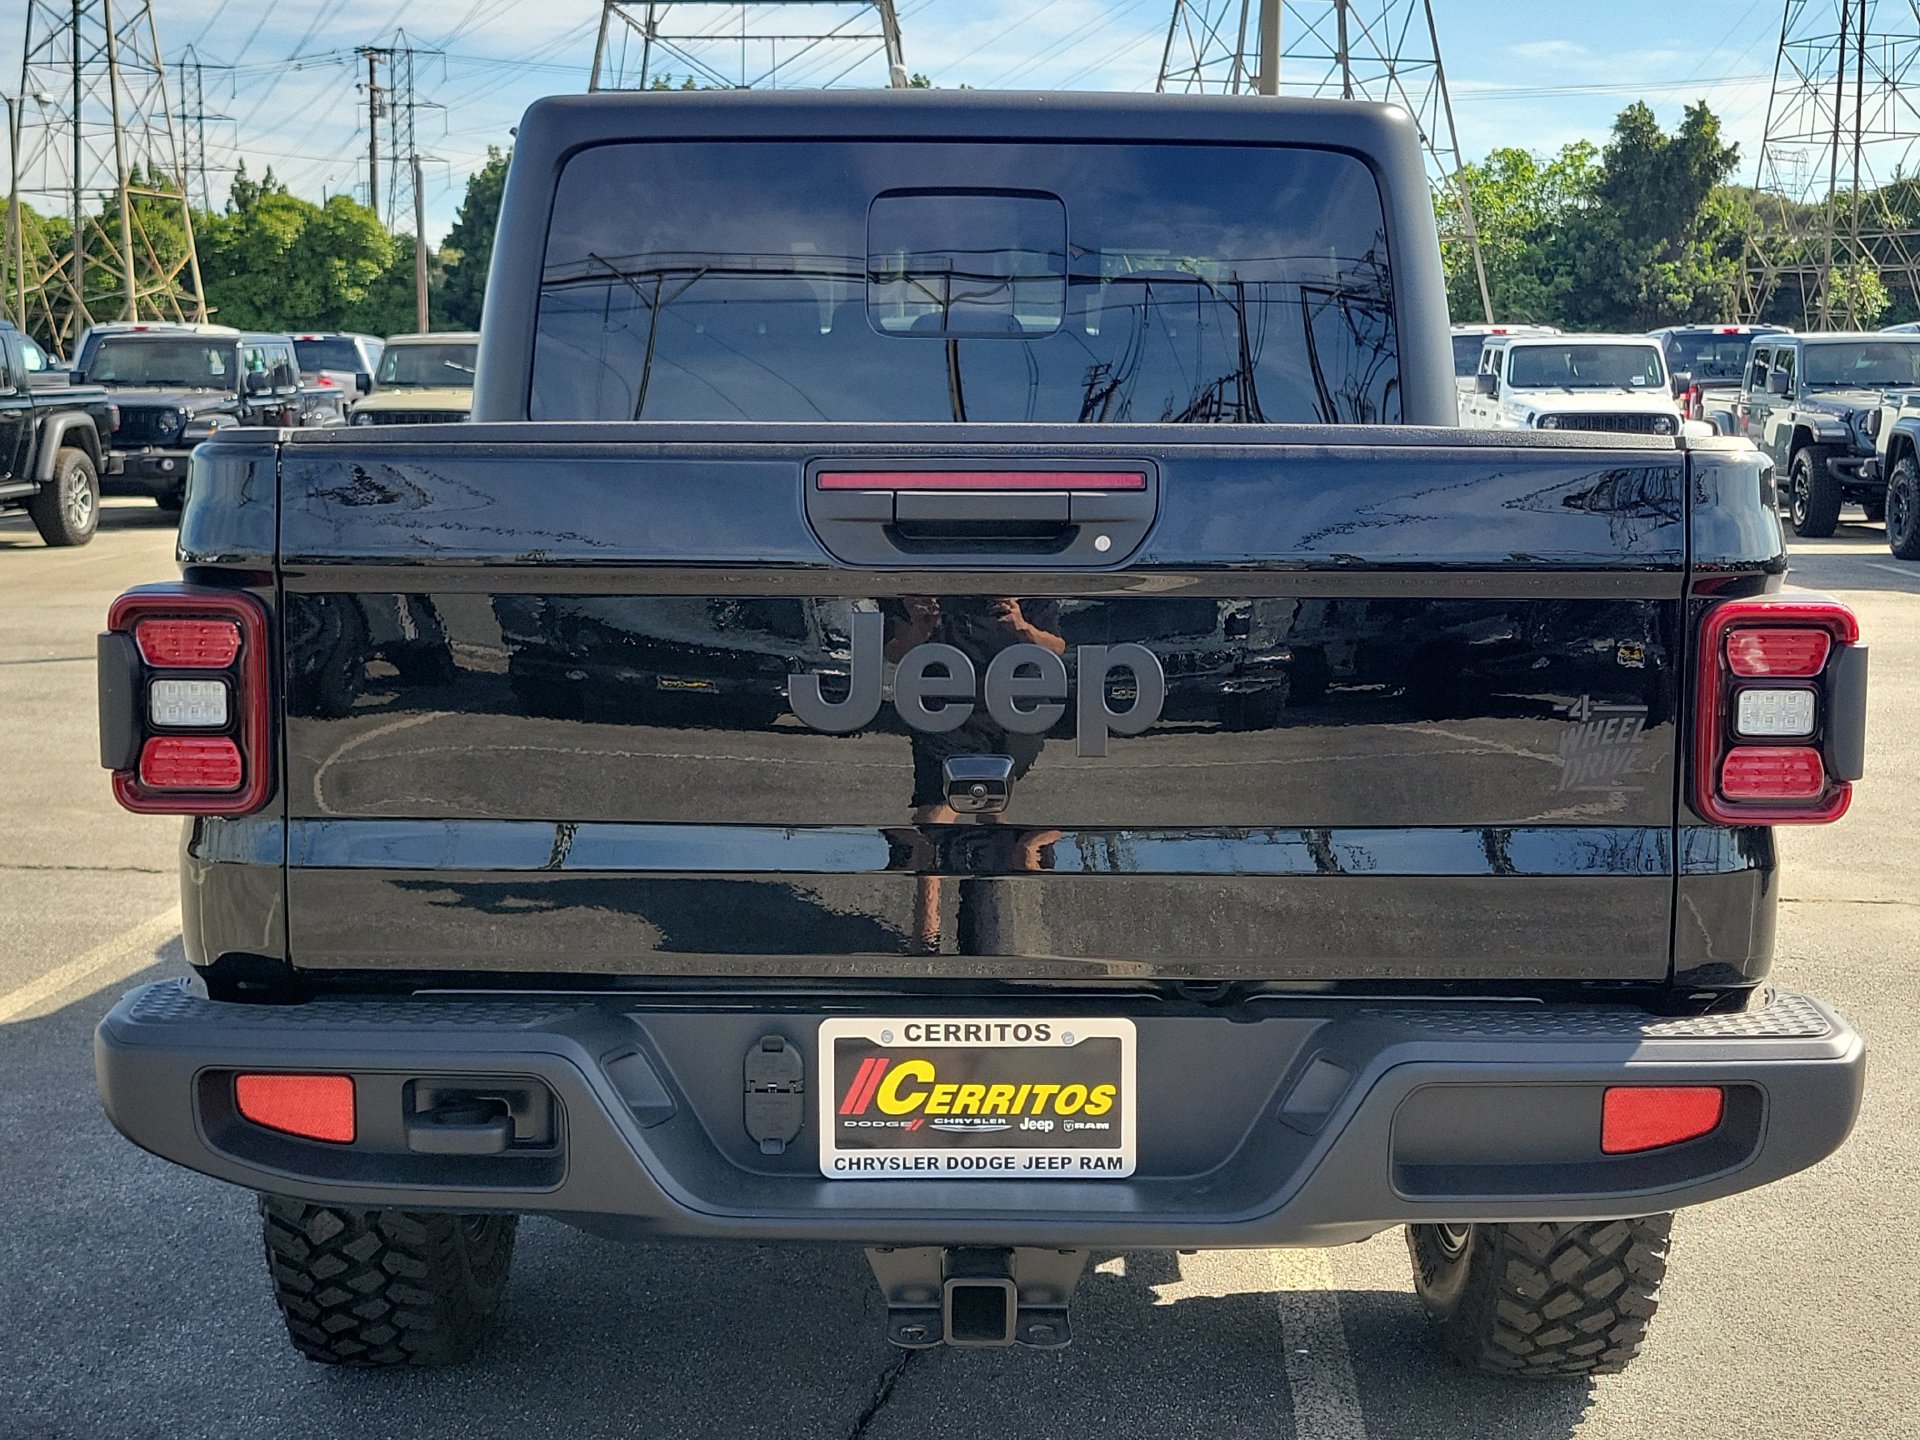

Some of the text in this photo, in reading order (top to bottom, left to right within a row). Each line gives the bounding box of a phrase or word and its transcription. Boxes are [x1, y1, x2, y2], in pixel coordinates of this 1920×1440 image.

[788, 612, 1165, 758] Jeep
[1568, 694, 1592, 722] 4
[1559, 717, 1646, 757] WHEEL
[1558, 748, 1643, 792] DRIVE
[904, 1023, 1051, 1042] CERRITOS
[876, 1058, 1117, 1116] CERRITOS
[933, 1117, 1006, 1125] CHRYSLER
[1019, 1116, 1055, 1133] Jeep
[1074, 1121, 1110, 1130] RAM
[833, 1156, 1123, 1171] CHRYSLER DODGE JEEP RAM
